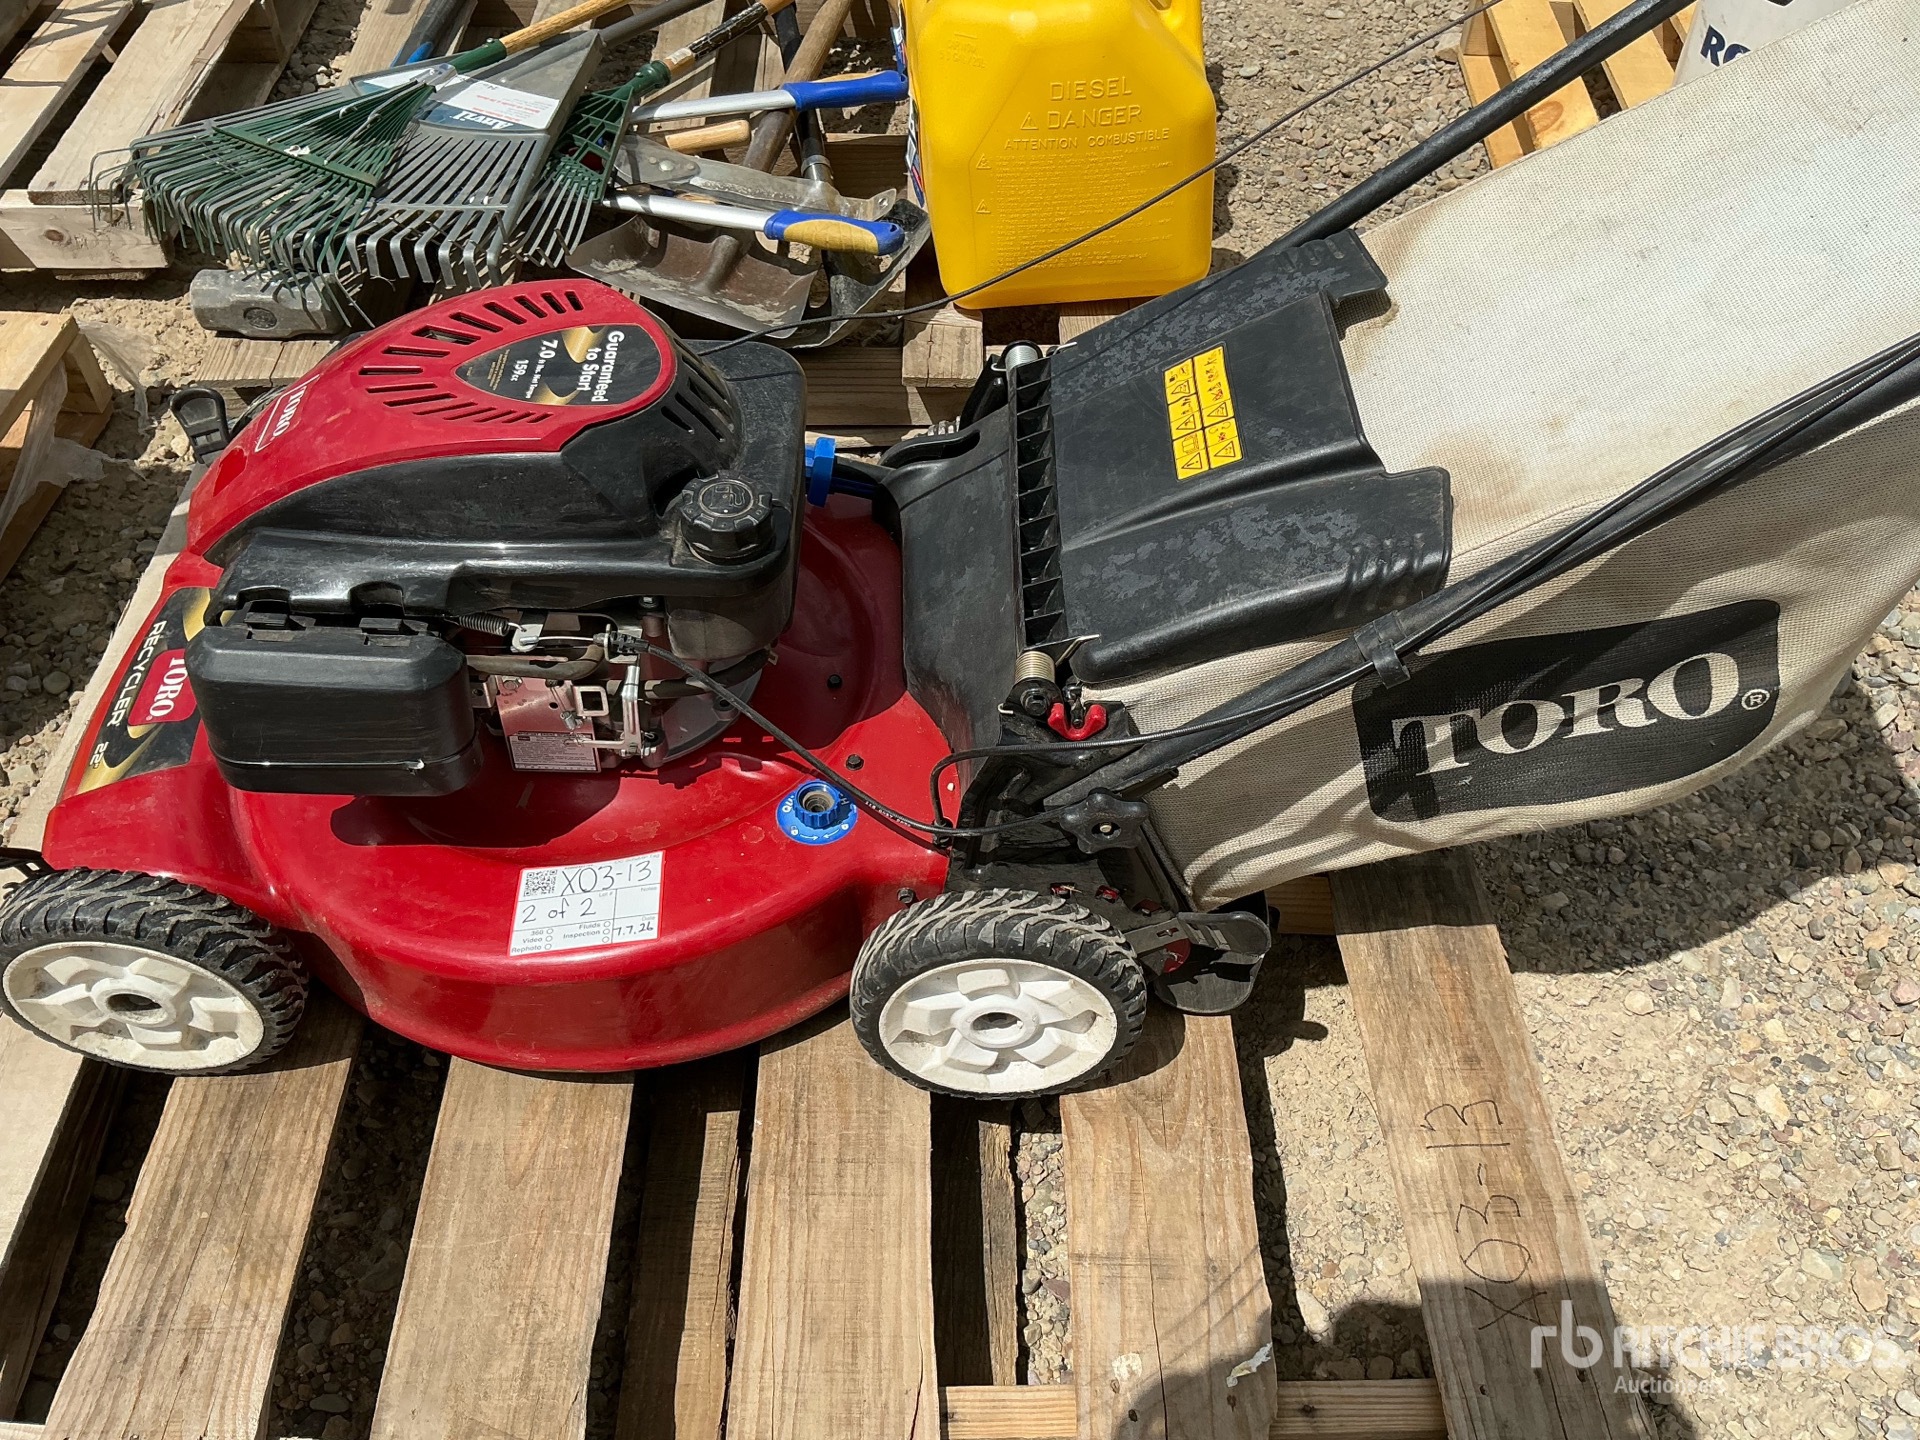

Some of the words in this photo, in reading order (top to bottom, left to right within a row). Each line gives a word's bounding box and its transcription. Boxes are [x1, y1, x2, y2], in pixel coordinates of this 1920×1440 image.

[1049, 76, 1133, 101] DIESEL
[452, 110, 514, 130] Anvil
[1046, 104, 1143, 130] DANGER
[1004, 136, 1078, 151] ATTENTION
[1087, 127, 1171, 148] COMBUSTIBLE
[539, 338, 559, 359] 7.0
[585, 346, 602, 361] to
[577, 363, 600, 391] Start
[591, 330, 625, 402] Guaranteed
[273, 385, 307, 437] TORO
[107, 620, 167, 727] RECYCLER
[1391, 652, 1739, 776] TORO
[561, 860, 652, 896] X03-13
[522, 904, 537, 924] 2
[548, 897, 570, 919] of
[580, 897, 597, 917] 2
[563, 929, 601, 940] Inspection
[579, 922, 601, 930] Fluids
[522, 936, 543, 944] Video
